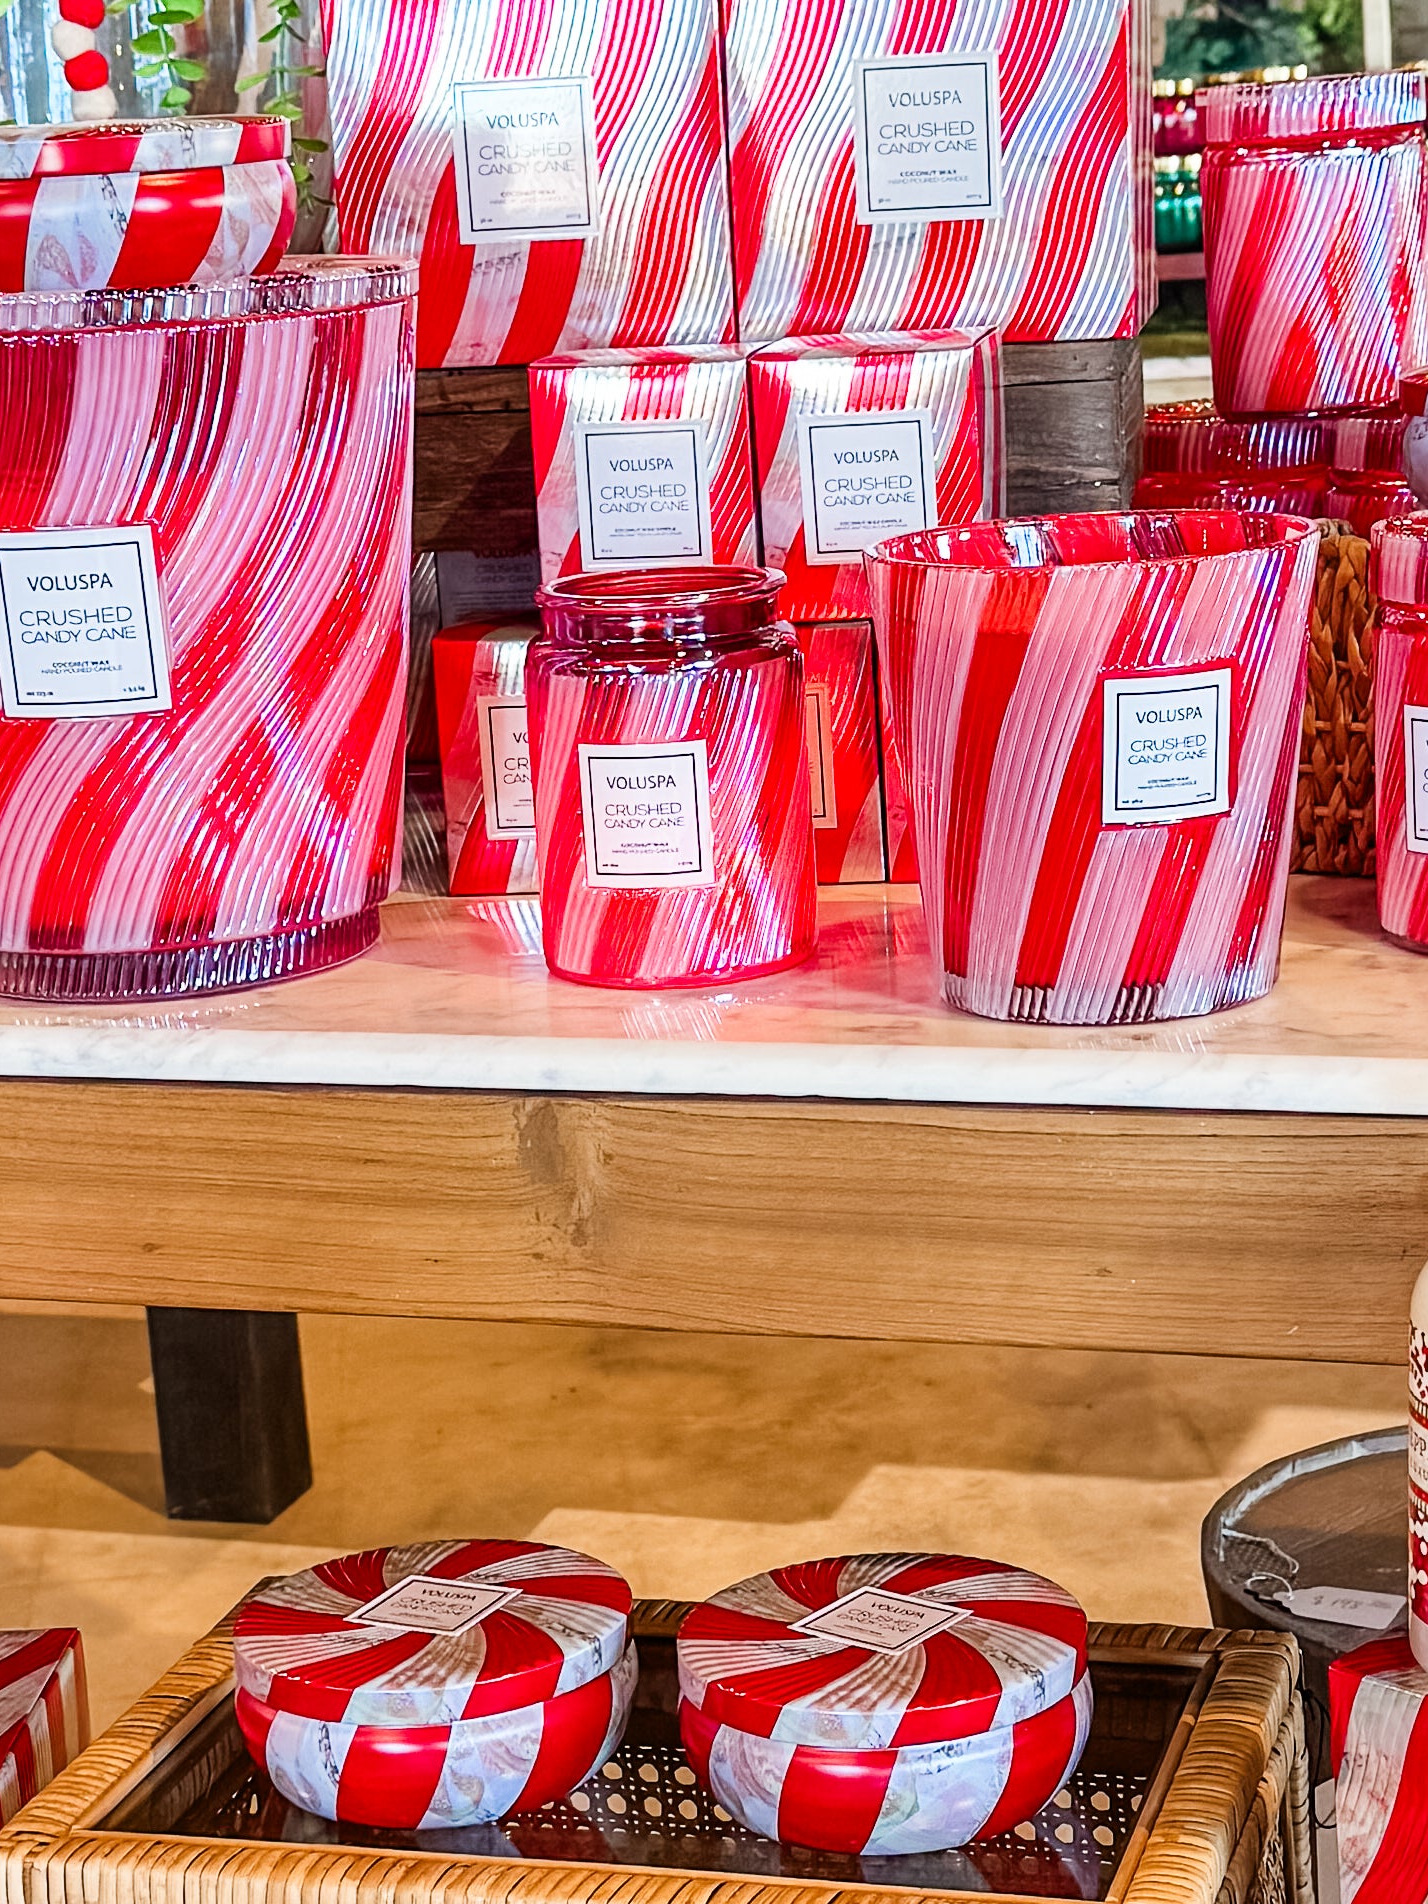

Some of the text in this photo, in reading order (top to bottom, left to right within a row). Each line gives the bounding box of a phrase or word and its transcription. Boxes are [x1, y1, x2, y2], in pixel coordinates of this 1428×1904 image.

[889, 90, 961, 107] VOLUSPA
[487, 112, 559, 128] VOLUSPA
[879, 121, 974, 139] CRUSHED
[480, 142, 571, 160] CRUSHED
[878, 139, 977, 155] CANDY CANE
[478, 160, 575, 175] CANDY CANE
[610, 458, 673, 471] VOLUSPA
[834, 449, 899, 464] VOLUSPA
[824, 475, 912, 492] CRUSHED
[600, 484, 686, 500] CRUSHED
[824, 492, 916, 507] CANDY CANE
[600, 500, 689, 513] CANDY CANE
[27, 573, 113, 591] VOLUSPA
[20, 607, 132, 626] CRUSHED
[21, 626, 136, 644] CANDY CANE
[1136, 707, 1202, 724] VOLUSPA
[1131, 734, 1206, 752] CRUSHED
[1128, 749, 1208, 764] CANDY CANE
[607, 775, 676, 789] VOLUSPA
[605, 802, 681, 816] CRUSHED
[604, 817, 684, 828] CANDY CANE
